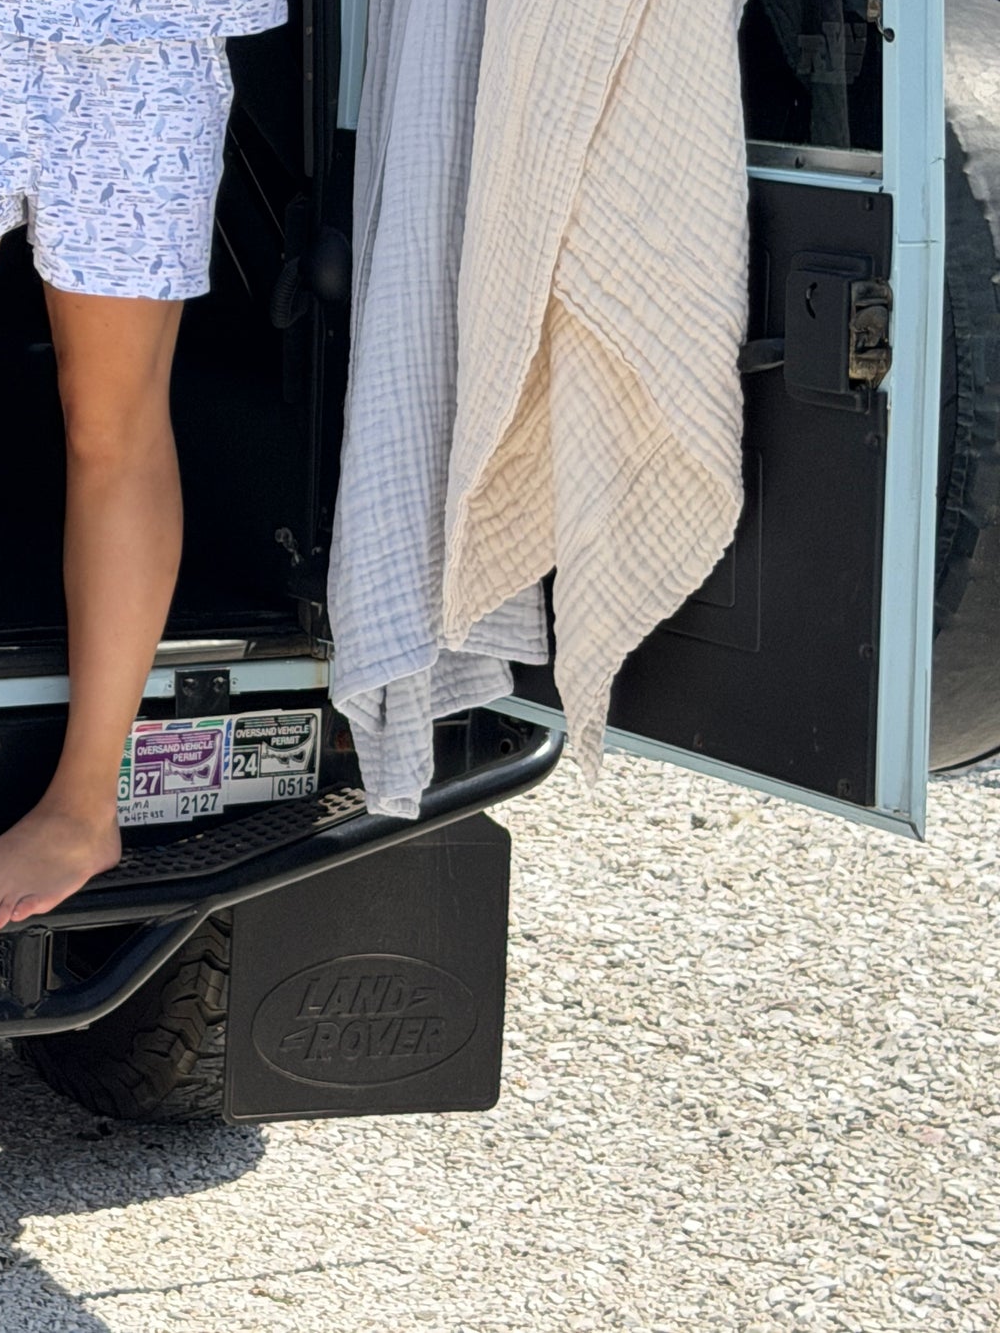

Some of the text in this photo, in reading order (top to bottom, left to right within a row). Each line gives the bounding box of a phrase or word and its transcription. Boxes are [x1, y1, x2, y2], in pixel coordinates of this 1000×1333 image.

[235, 724, 310, 739] OVERSAND VEHICLE
[270, 735, 300, 746] PERMIT
[137, 740, 214, 756] OVERSAND VEHICLE
[173, 751, 202, 762] PERMIT
[232, 752, 257, 777] 24
[134, 770, 160, 795] 27
[277, 776, 314, 797] 0515
[180, 792, 219, 815] 2127
[297, 975, 407, 1019] LAND
[304, 1017, 445, 1061] ROVER
